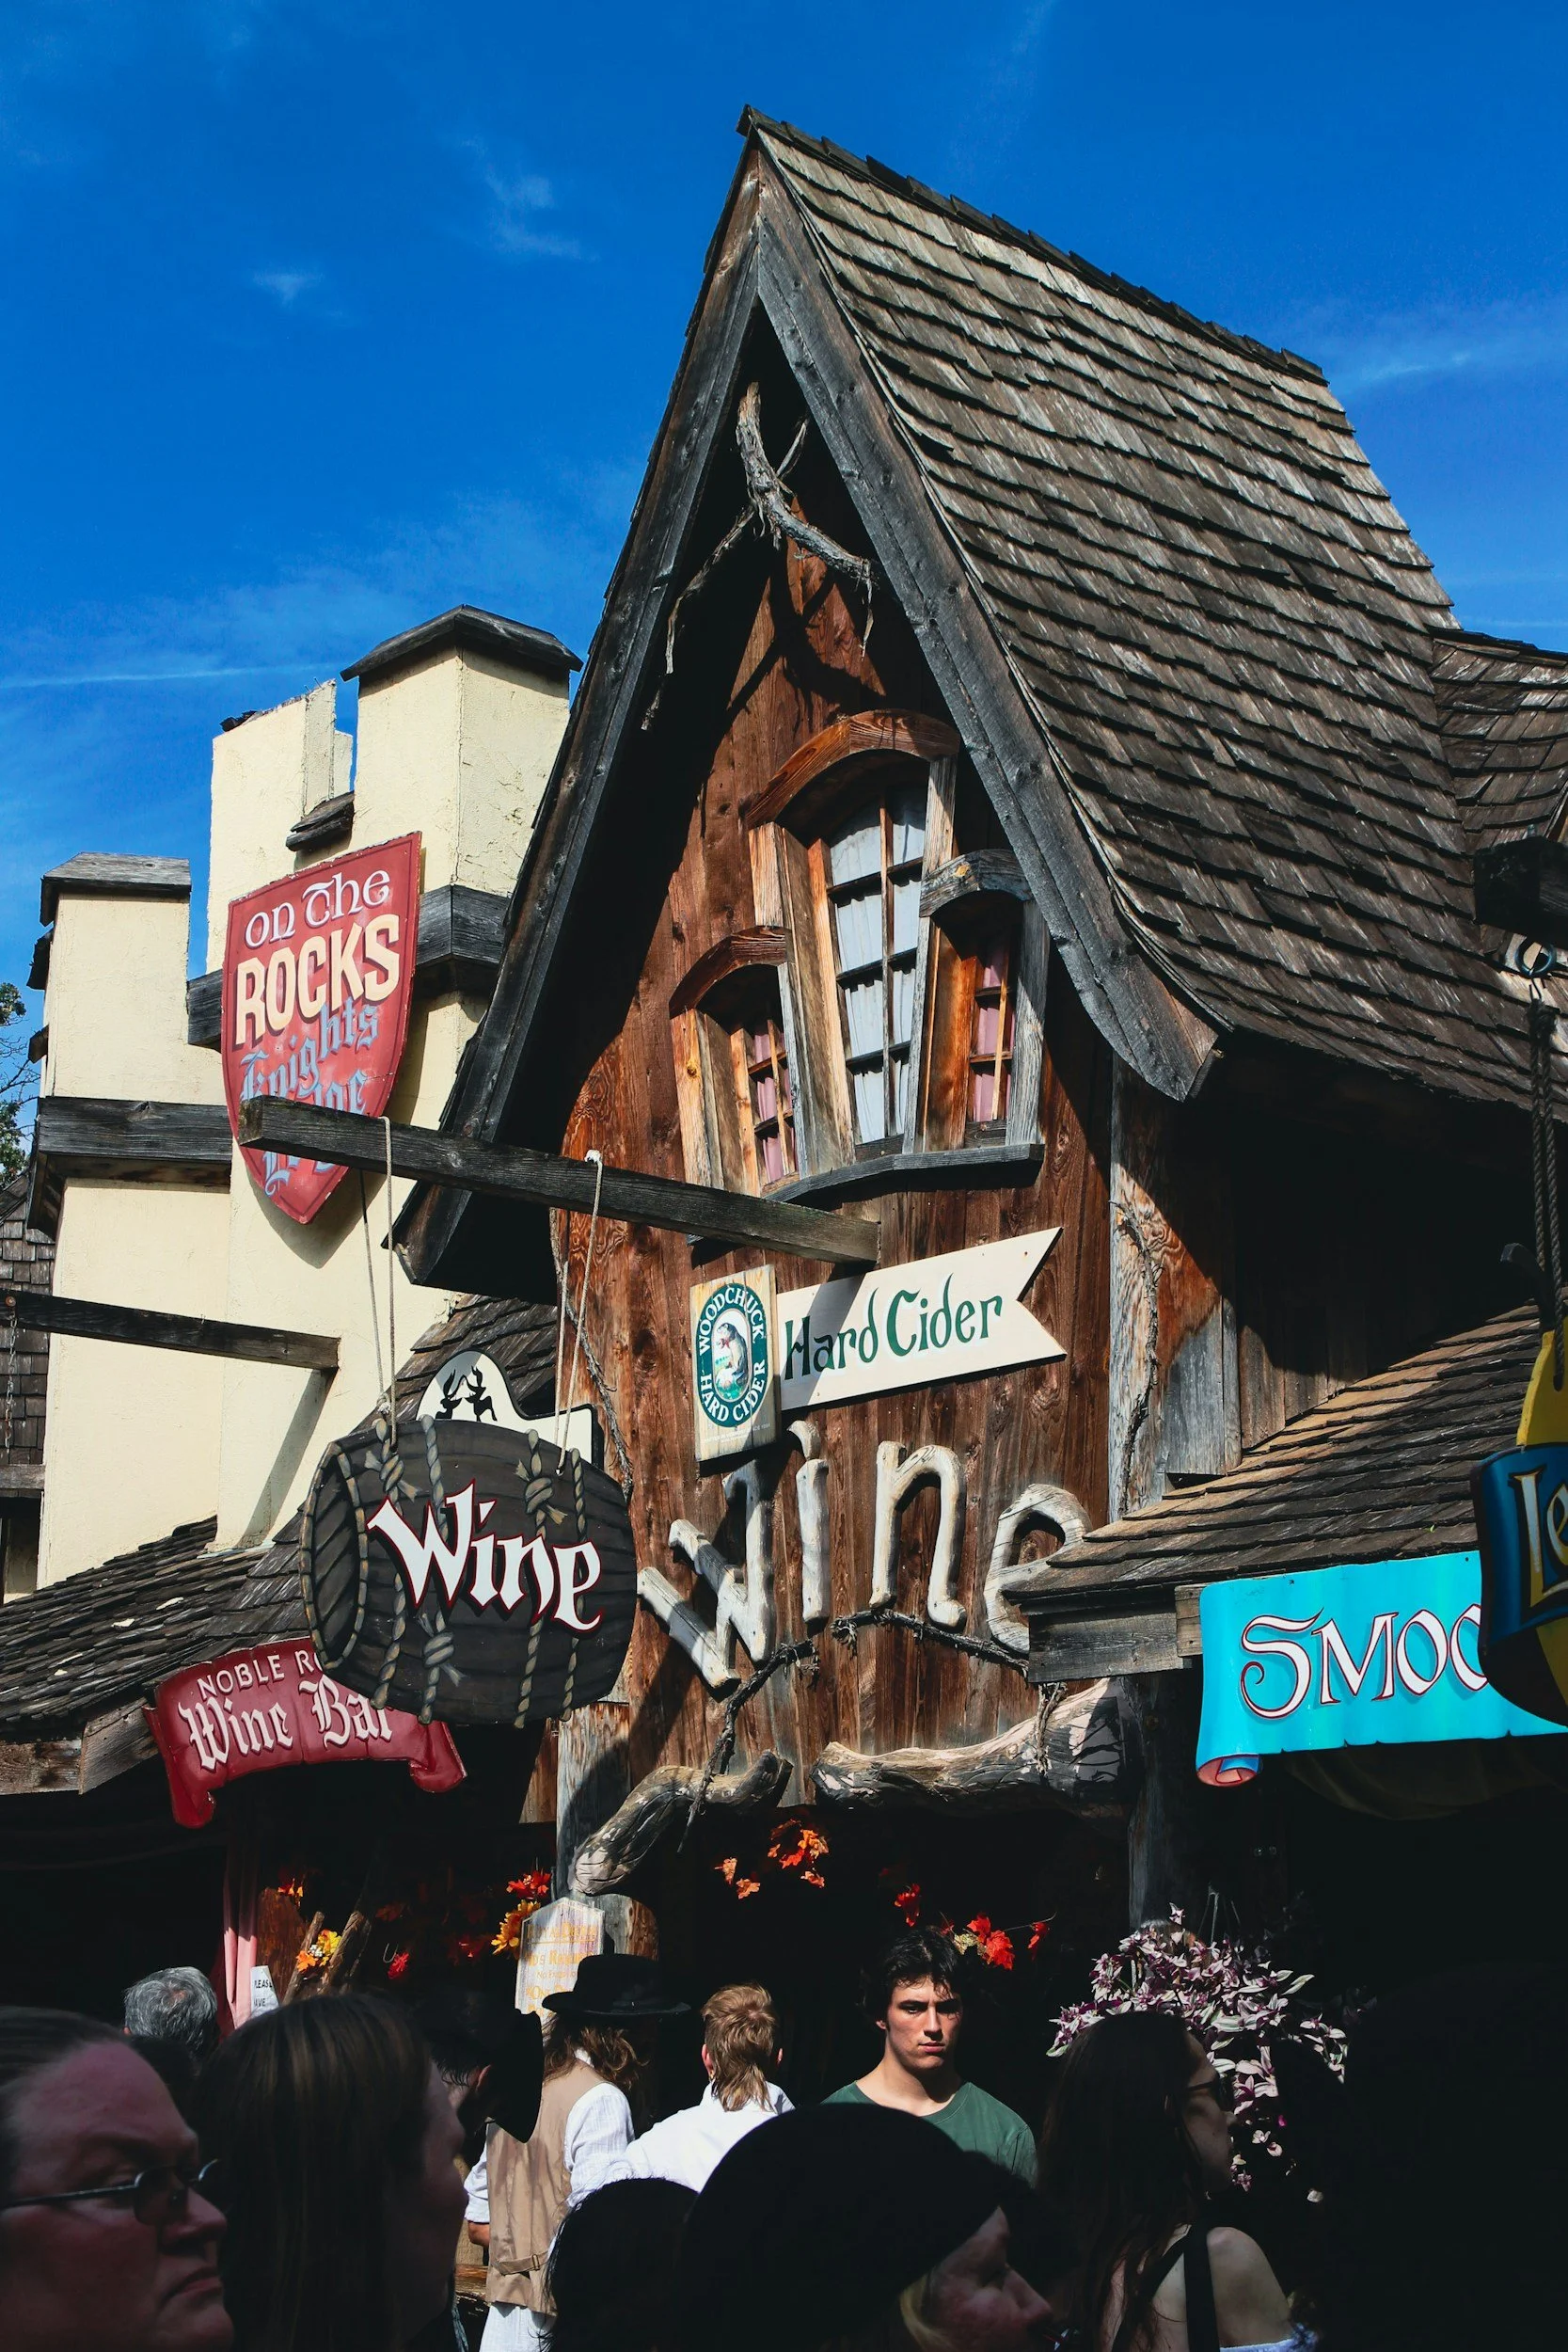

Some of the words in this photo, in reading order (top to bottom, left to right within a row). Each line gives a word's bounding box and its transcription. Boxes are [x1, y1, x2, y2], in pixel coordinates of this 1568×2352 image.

[302, 868, 390, 930] The
[235, 913, 401, 1046] ROCKS
[698, 1285, 767, 1357] WOODCHUCK
[784, 1287, 879, 1380] Hard
[886, 1273, 1003, 1357] Cider
[700, 1373, 730, 1422] HARD
[733, 1359, 766, 1422] CIDER
[367, 1478, 602, 1632] Wine
[198, 1650, 285, 1699] NOBLE
[178, 1697, 294, 1772] Wine
